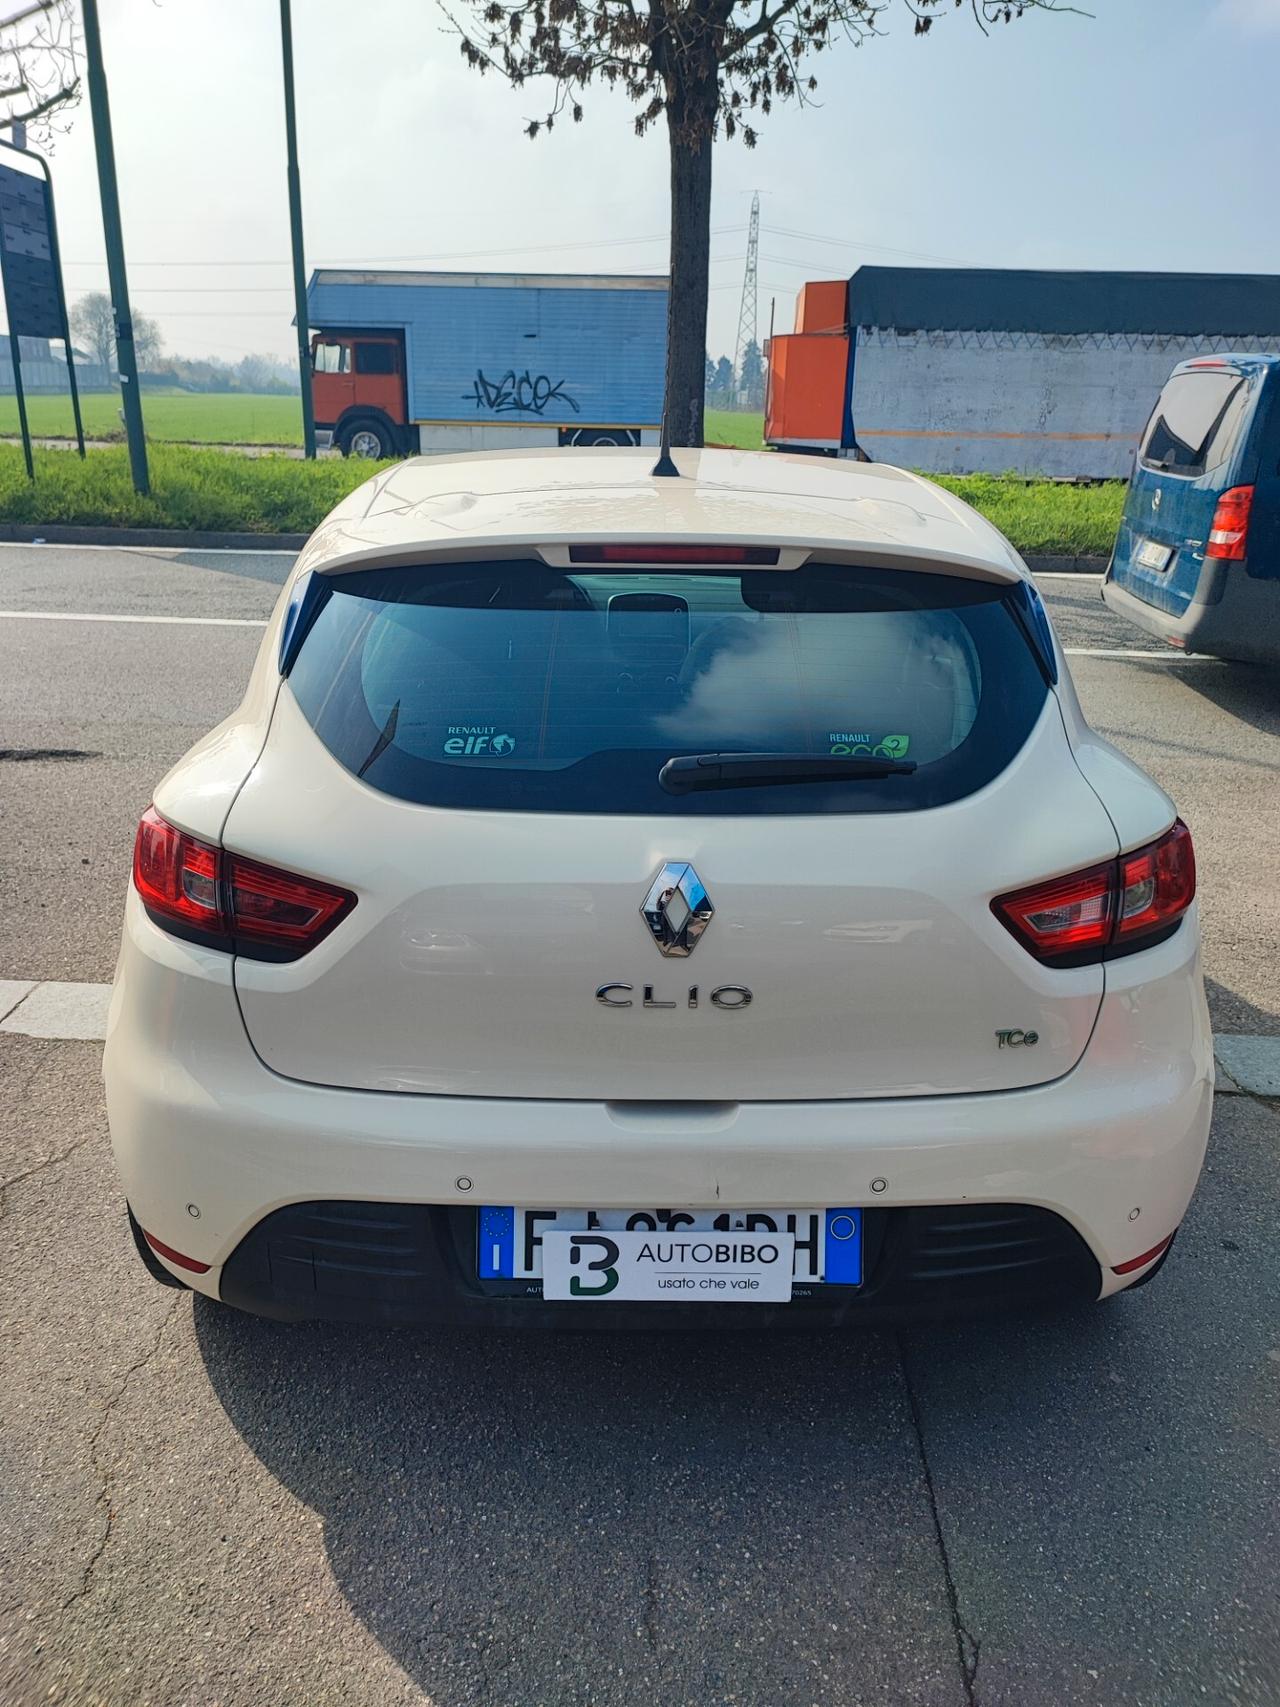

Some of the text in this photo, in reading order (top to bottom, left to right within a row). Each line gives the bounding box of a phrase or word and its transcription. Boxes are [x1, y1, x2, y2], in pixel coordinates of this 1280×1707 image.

[448, 726, 496, 734] RENAULT
[829, 733, 870, 742] RENAULT
[444, 736, 489, 754] elf
[596, 982, 753, 1010] CLIO
[995, 1029, 1039, 1049] TCe
[636, 1243, 779, 1264] AUTOBIBO
[658, 1278, 760, 1290] usato che vale
